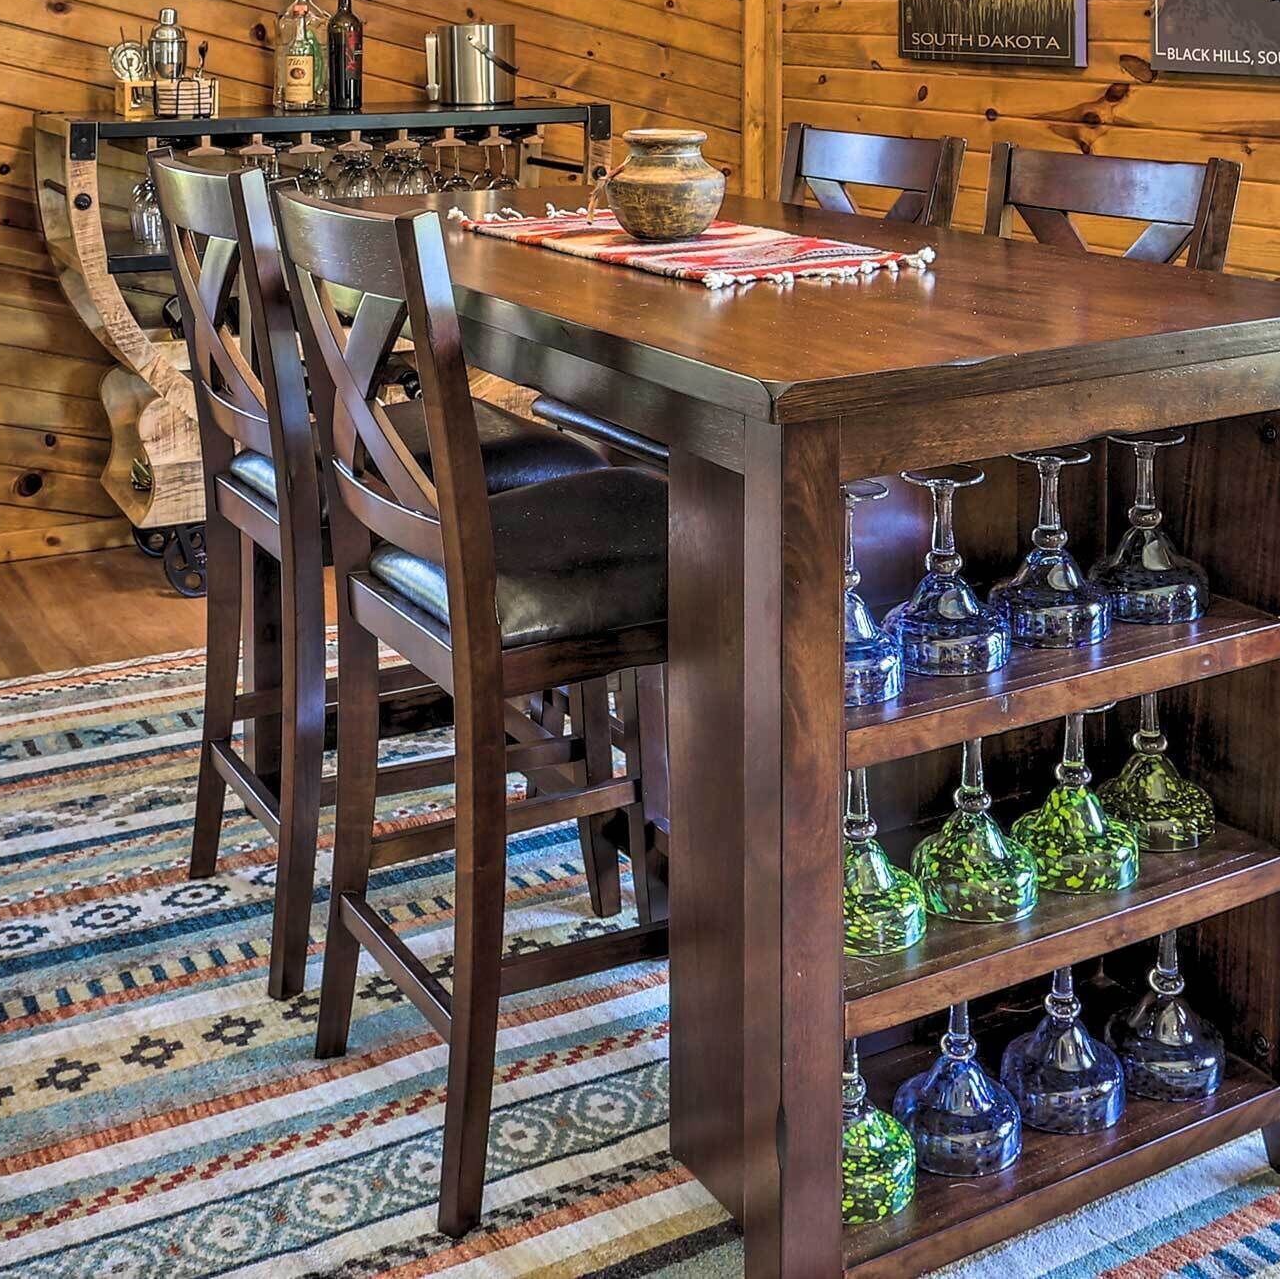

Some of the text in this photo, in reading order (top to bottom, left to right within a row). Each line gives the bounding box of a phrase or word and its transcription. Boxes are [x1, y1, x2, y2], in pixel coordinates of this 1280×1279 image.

[911, 32, 1061, 50] SOUTH DAKOTA
[1167, 47, 1209, 62] BLACK
[1213, 49, 1255, 66] HILLS,
